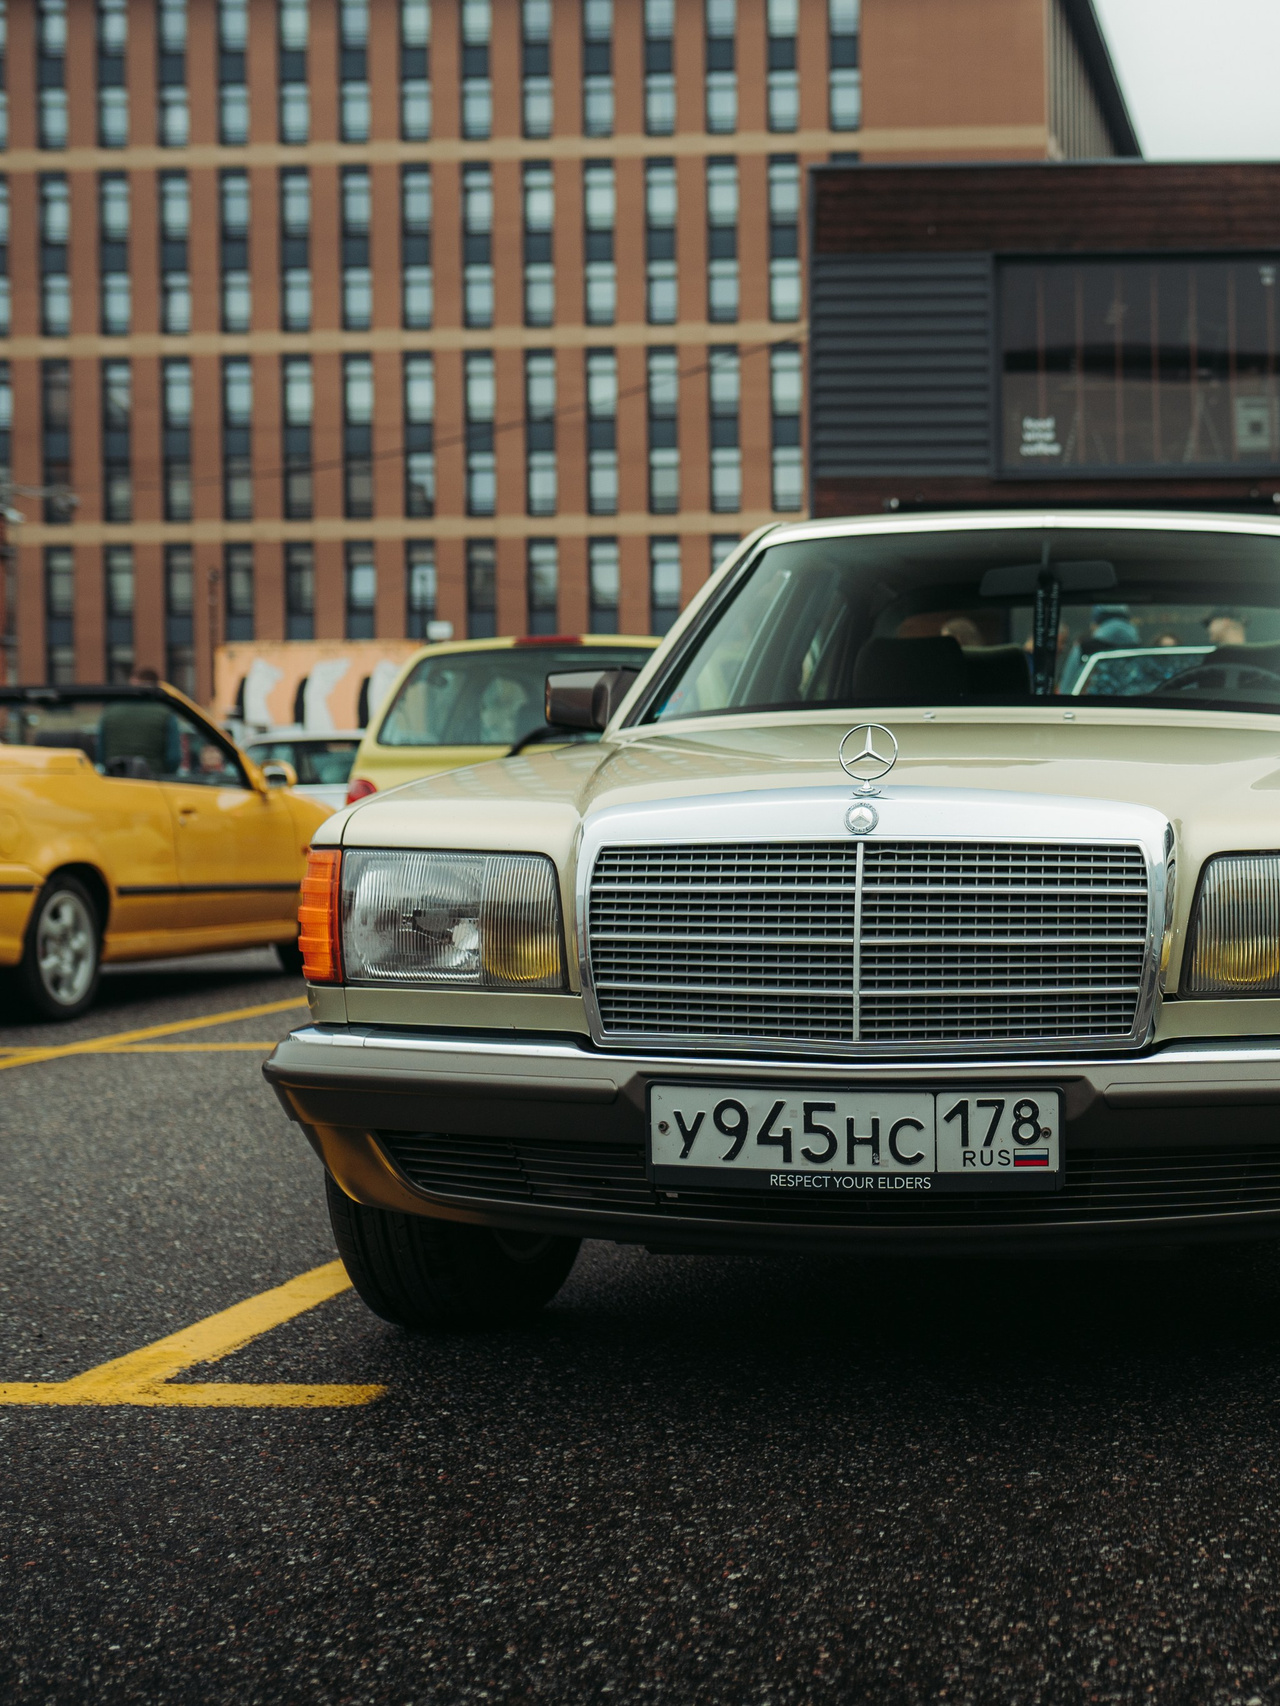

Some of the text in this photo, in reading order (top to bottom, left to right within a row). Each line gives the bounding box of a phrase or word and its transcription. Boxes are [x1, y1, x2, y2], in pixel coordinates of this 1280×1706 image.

[943, 1099, 1042, 1147] 178
[963, 1150, 1011, 1167] RUS
[770, 1174, 932, 1189] RESPECT YOUR ELDERS
